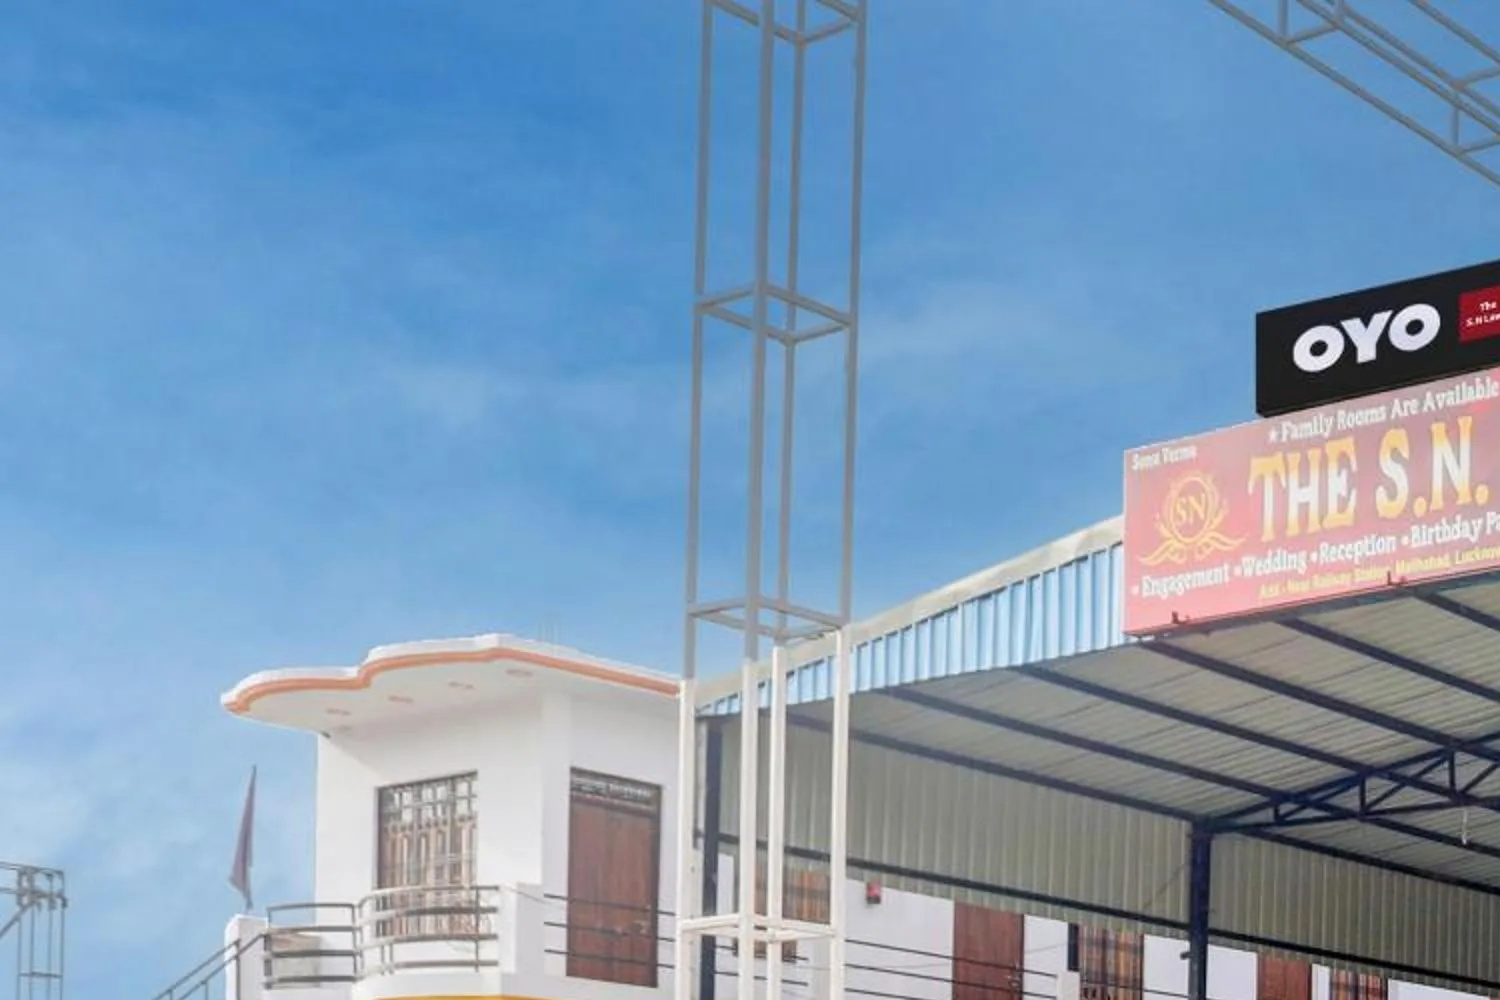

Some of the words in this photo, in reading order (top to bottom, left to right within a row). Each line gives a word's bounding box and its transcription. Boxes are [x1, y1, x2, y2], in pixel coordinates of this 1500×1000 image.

[1293, 303, 1440, 373] OYO
[1281, 416, 1333, 442] Family
[1337, 404, 1386, 430] Rooms
[1391, 397, 1417, 419] Are
[1422, 379, 1499, 412] Available
[1247, 435, 1360, 543] THE
[1375, 416, 1490, 528] S.N.
[1142, 563, 1230, 600] Engagement
[1241, 547, 1308, 576] Wedding
[1319, 534, 1397, 565] Reception
[1411, 514, 1483, 548] Birthday
